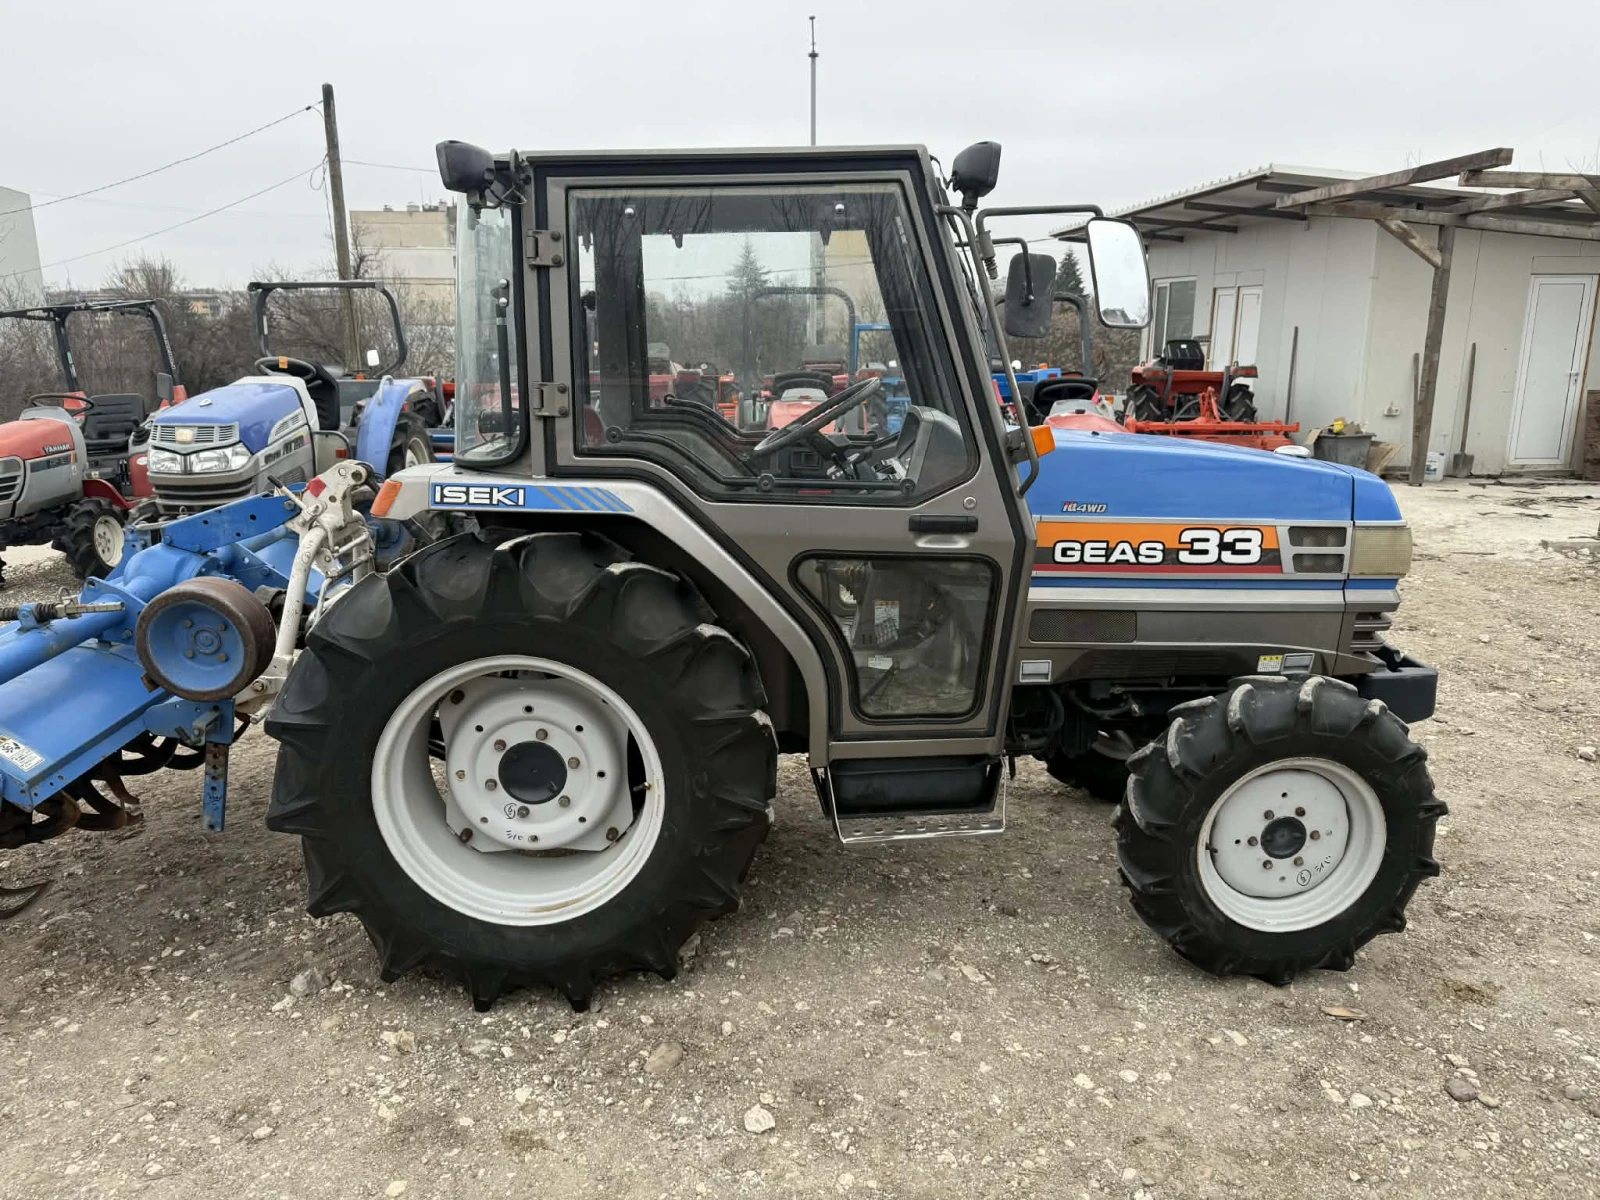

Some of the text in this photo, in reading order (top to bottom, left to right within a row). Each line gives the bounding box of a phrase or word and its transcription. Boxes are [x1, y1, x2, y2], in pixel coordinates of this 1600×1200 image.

[434, 484, 526, 506] ISEKI
[1053, 528, 1263, 564] GEAS 33
